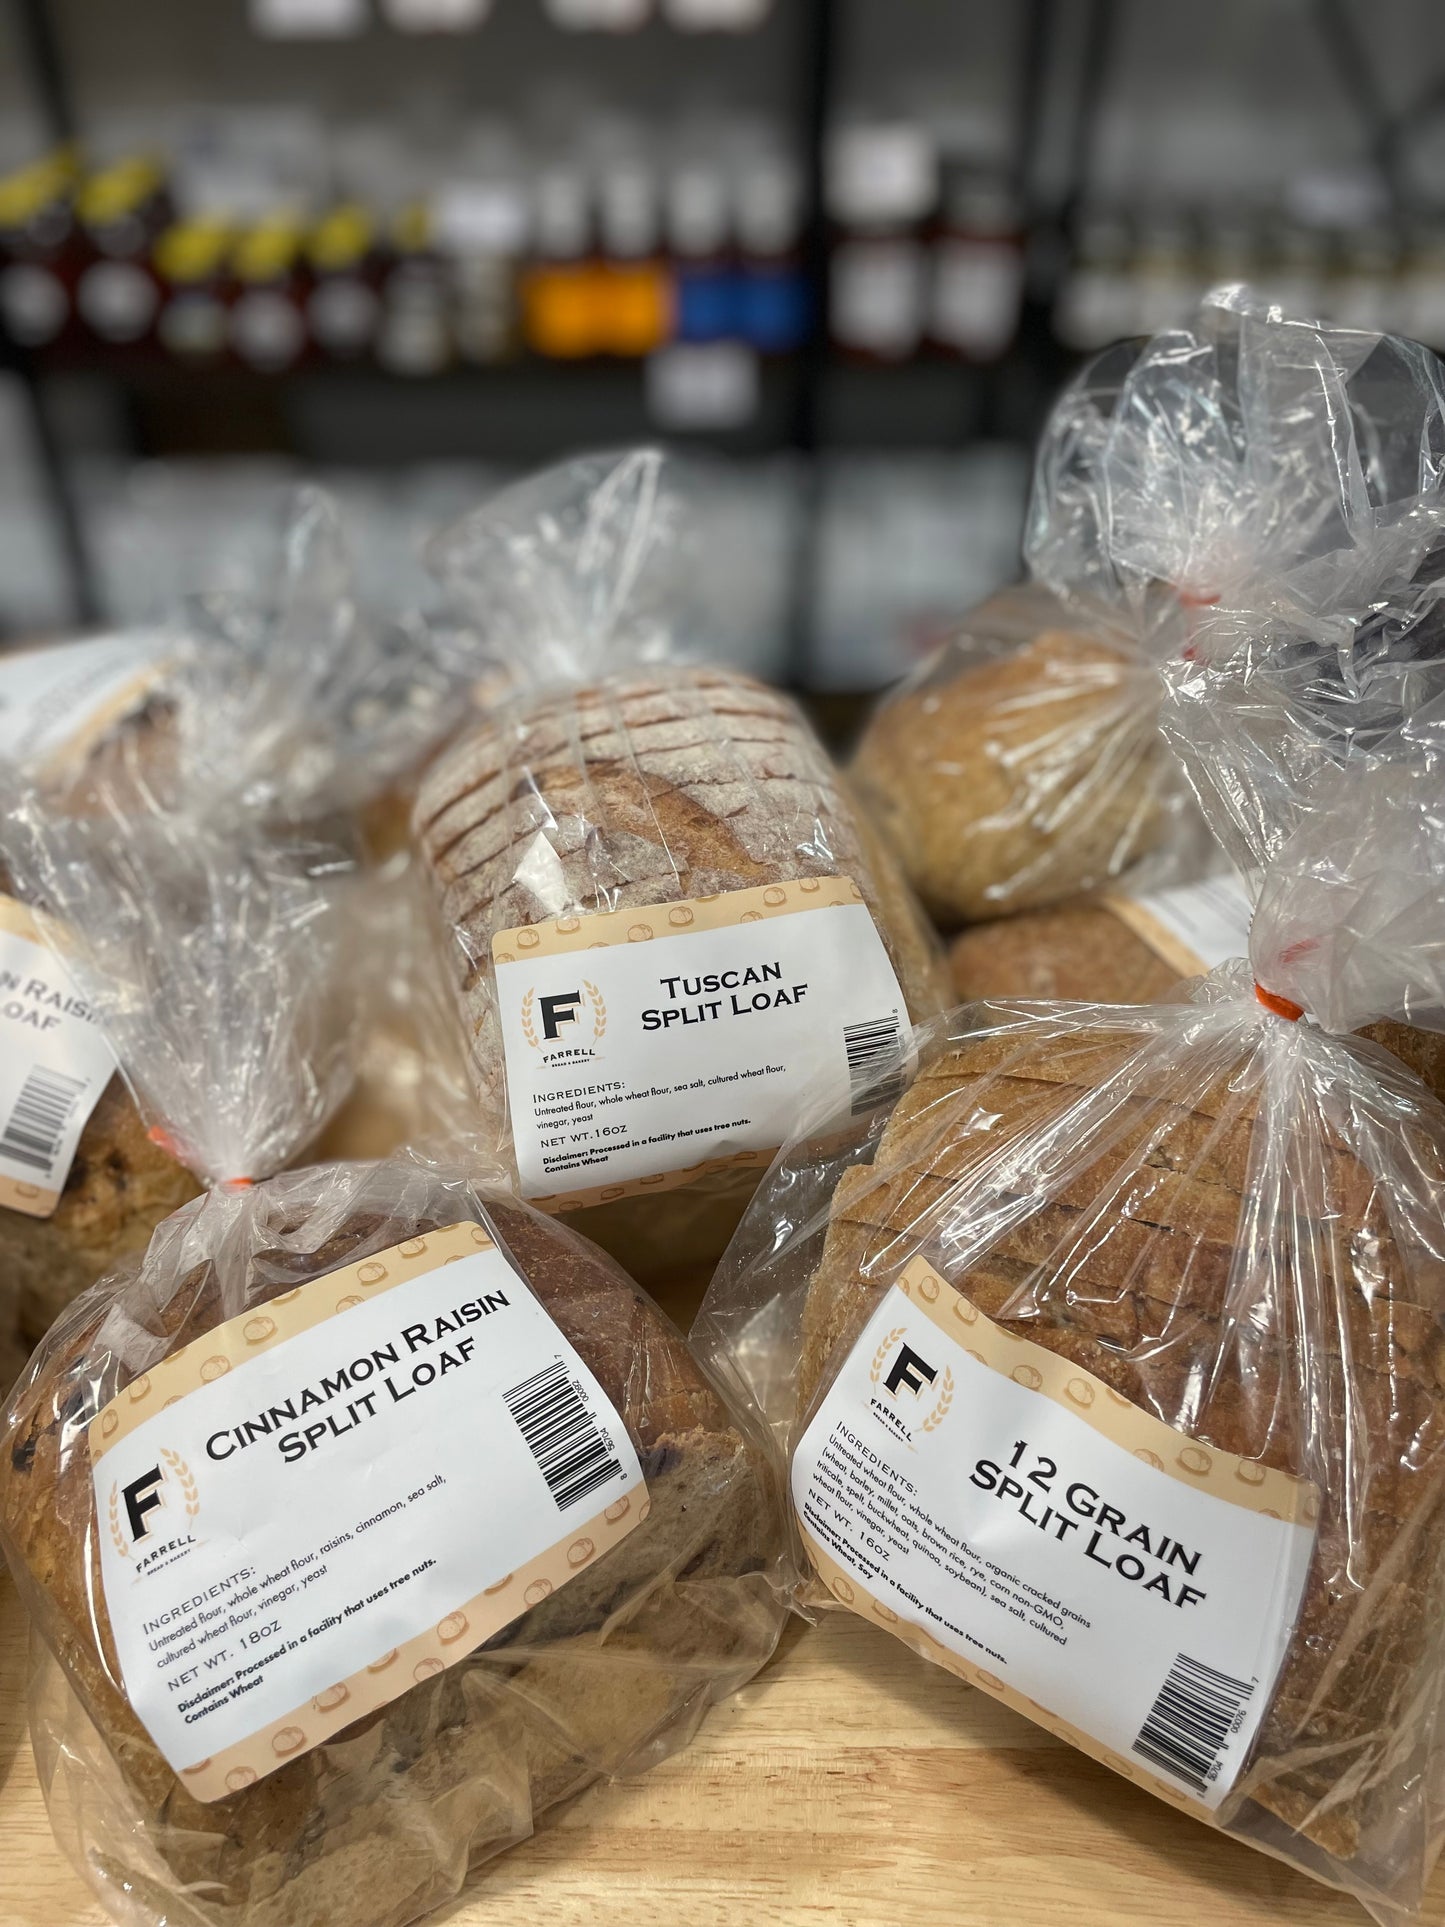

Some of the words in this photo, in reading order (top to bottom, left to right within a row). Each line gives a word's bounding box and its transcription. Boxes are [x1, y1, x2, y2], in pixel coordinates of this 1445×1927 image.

[537, 989, 584, 1041] F
[641, 1001, 722, 1030] SPLIT
[730, 984, 808, 1016] LOAF
[660, 962, 782, 999] TUSCAN
[543, 1048, 596, 1063] FARRELL
[533, 1081, 625, 1103] INGREDIENTS:
[534, 1102, 574, 1116] Untreated
[575, 1100, 597, 1110] flour,
[598, 1095, 623, 1106] whole
[624, 1089, 650, 1101] wheat
[650, 1087, 672, 1096] flour,
[674, 1083, 688, 1092] sea
[690, 1079, 706, 1088] salt,
[707, 1072, 739, 1085] cultured
[740, 1068, 765, 1079] wheat
[765, 1065, 786, 1074] flour,
[536, 1119, 570, 1130] vinegar,
[571, 1114, 593, 1126] yeast
[540, 1136, 566, 1148] NET
[543, 1151, 589, 1165] Disclaimer:
[589, 1142, 631, 1155] Processed
[648, 1133, 675, 1147] facility
[677, 1129, 694, 1138] that
[695, 1126, 713, 1135] uses
[714, 1122, 730, 1131] tree
[731, 1119, 751, 1127] nuts.
[544, 1161, 581, 1174] Contains
[581, 1155, 609, 1166] Wheat
[206, 1343, 400, 1461] CINNAMON
[400, 1290, 511, 1354] RAISIN
[278, 1391, 378, 1464] SPLIT
[384, 1336, 475, 1403] LOAF
[882, 1342, 939, 1401] F
[870, 1398, 912, 1442] FARRELL
[620, 1472, 628, 1481] 8
[836, 1421, 918, 1496] INGREDIENTS:
[121, 1463, 169, 1544] F
[808, 1488, 831, 1511] NET
[834, 1510, 853, 1532] WT.
[860, 1531, 891, 1562] 16OZ
[813, 1473, 835, 1494] wheat
[835, 1490, 854, 1512] flour,
[856, 1508, 886, 1538] vinegar,
[887, 1535, 910, 1555] yeast
[822, 1446, 848, 1475] (wheat,
[849, 1470, 875, 1498] barley,
[877, 1495, 899, 1517] millet,
[901, 1513, 919, 1533] oats,
[922, 1528, 948, 1554] brown
[949, 1551, 967, 1569] rice,
[969, 1566, 987, 1582] rye,
[990, 1578, 1011, 1596] corn
[1012, 1593, 1065, 1630] non-GMO,
[829, 1434, 863, 1469] Untreated
[863, 1466, 887, 1489] wheat
[887, 1484, 906, 1507] flour,
[909, 1502, 933, 1526] whole
[934, 1523, 960, 1547] wheat
[960, 1542, 983, 1564] flour,
[985, 1562, 1021, 1586] organic
[1022, 1583, 1061, 1609] cracked
[1060, 1607, 1091, 1629] grains
[968, 1459, 1079, 1542] SPLIT
[1083, 1529, 1207, 1609] LOAF
[1008, 1439, 1057, 1494] 12
[1065, 1483, 1203, 1576] GRAIN
[136, 1535, 196, 1573] FARRELL
[149, 1617, 198, 1651] Untreated
[198, 1605, 227, 1624] flour,
[227, 1586, 259, 1607] whole
[260, 1566, 291, 1589] wheat
[290, 1552, 319, 1571] flour,
[320, 1531, 354, 1555] raisins,
[355, 1501, 406, 1533] cinnamon,
[407, 1487, 425, 1503] sea
[426, 1474, 447, 1491] salt,
[803, 1510, 830, 1542] Contains
[831, 1539, 856, 1567] Wheat,
[857, 1564, 874, 1580] Soy
[816, 1460, 844, 1489] triticale,
[845, 1485, 865, 1505] spelt,
[867, 1500, 910, 1541] buckwheat,
[912, 1538, 942, 1567] quinoa,
[944, 1564, 987, 1597] soybean),
[990, 1594, 1007, 1608] sea
[1008, 1605, 1026, 1622] salt,
[1029, 1619, 1068, 1646] cultured
[142, 1566, 256, 1635] INGREDIENTS:
[156, 1638, 197, 1669] cultured
[197, 1622, 229, 1645] wheat
[229, 1607, 257, 1627] flour,
[257, 1584, 299, 1610] vinegar,
[300, 1564, 328, 1589] yeast
[804, 1502, 842, 1541] Disclaimer:
[842, 1538, 881, 1574] Processed
[880, 1570, 889, 1581] in
[896, 1583, 924, 1609] facility
[925, 1606, 943, 1622] that
[943, 1619, 964, 1636] uses
[965, 1633, 984, 1649] tree
[985, 1647, 1008, 1665] nuts.
[167, 1666, 199, 1692] NET
[203, 1650, 234, 1670] WT.
[239, 1620, 282, 1649] 18OZ
[178, 1677, 235, 1713] Disclaimer:
[235, 1645, 287, 1681] Processed
[287, 1641, 299, 1650] in
[300, 1635, 307, 1643] a
[307, 1614, 342, 1638] facility
[343, 1599, 365, 1617] that
[366, 1587, 389, 1604] uses
[389, 1573, 411, 1590] tree
[412, 1558, 437, 1577] nuts.
[184, 1696, 229, 1724] Contains
[228, 1674, 264, 1699] Wheat
[1230, 1709, 1247, 1734] 00076
[1251, 1676, 1260, 1684] 7
